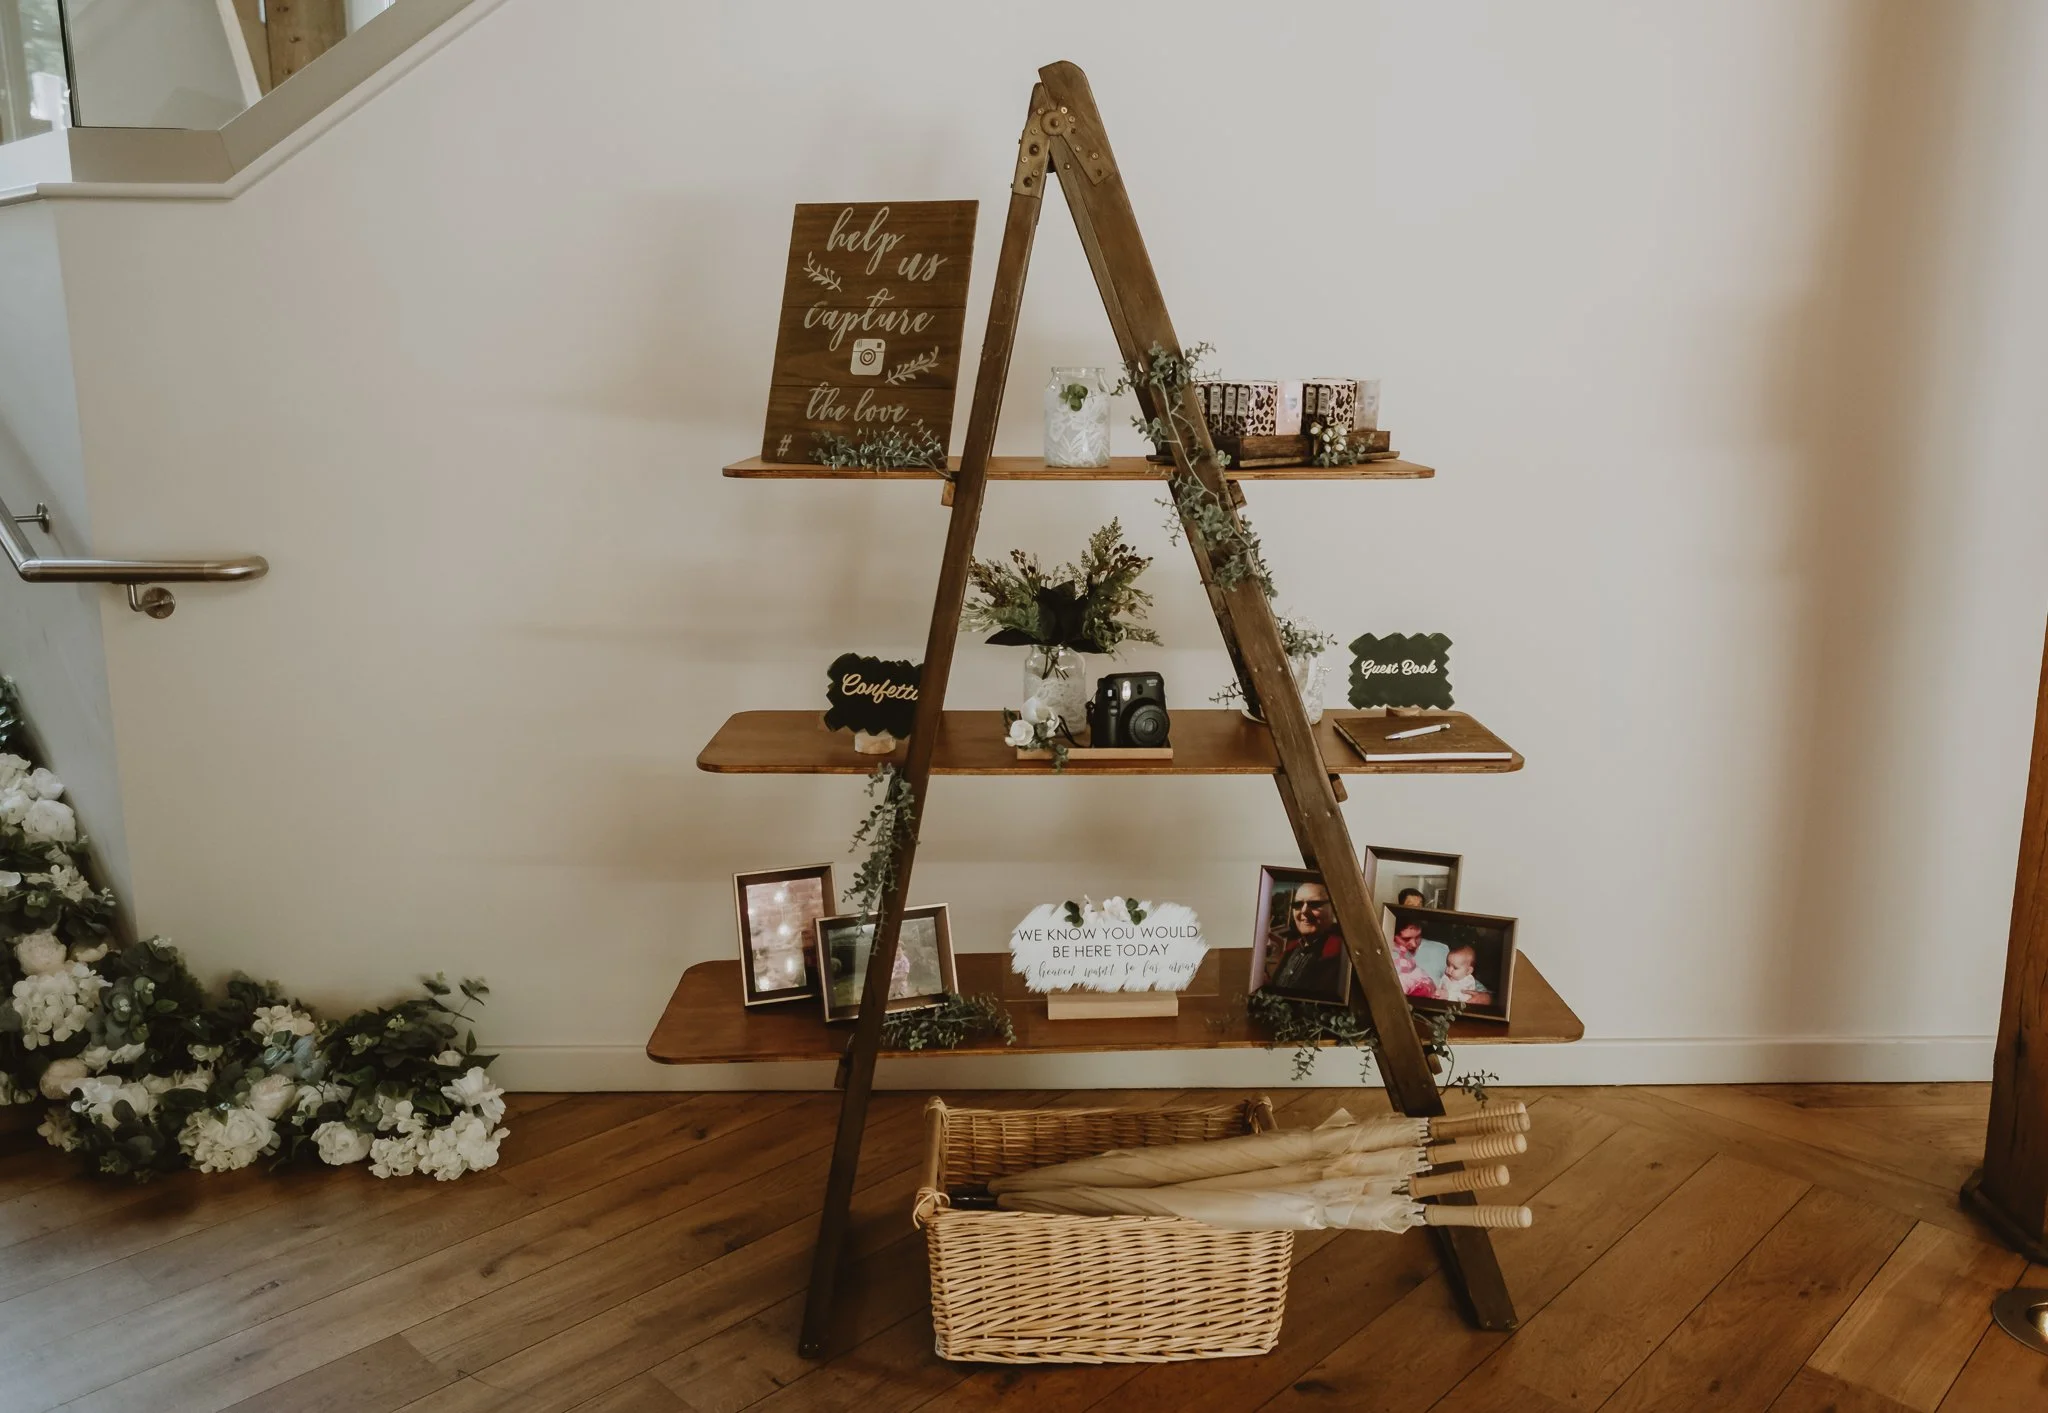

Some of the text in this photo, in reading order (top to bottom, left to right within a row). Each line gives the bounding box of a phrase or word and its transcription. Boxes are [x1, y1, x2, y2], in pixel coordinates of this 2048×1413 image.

[826, 206, 904, 275] help
[898, 253, 948, 281] us
[804, 288, 935, 351] capture
[806, 381, 909, 422] the love
[1361, 659, 1438, 679] Guest Book
[842, 673, 918, 703] Confetti
[1019, 926, 1197, 941] WE KNOW YOU WOULD
[1053, 944, 1169, 958] BE HERE TODAY
